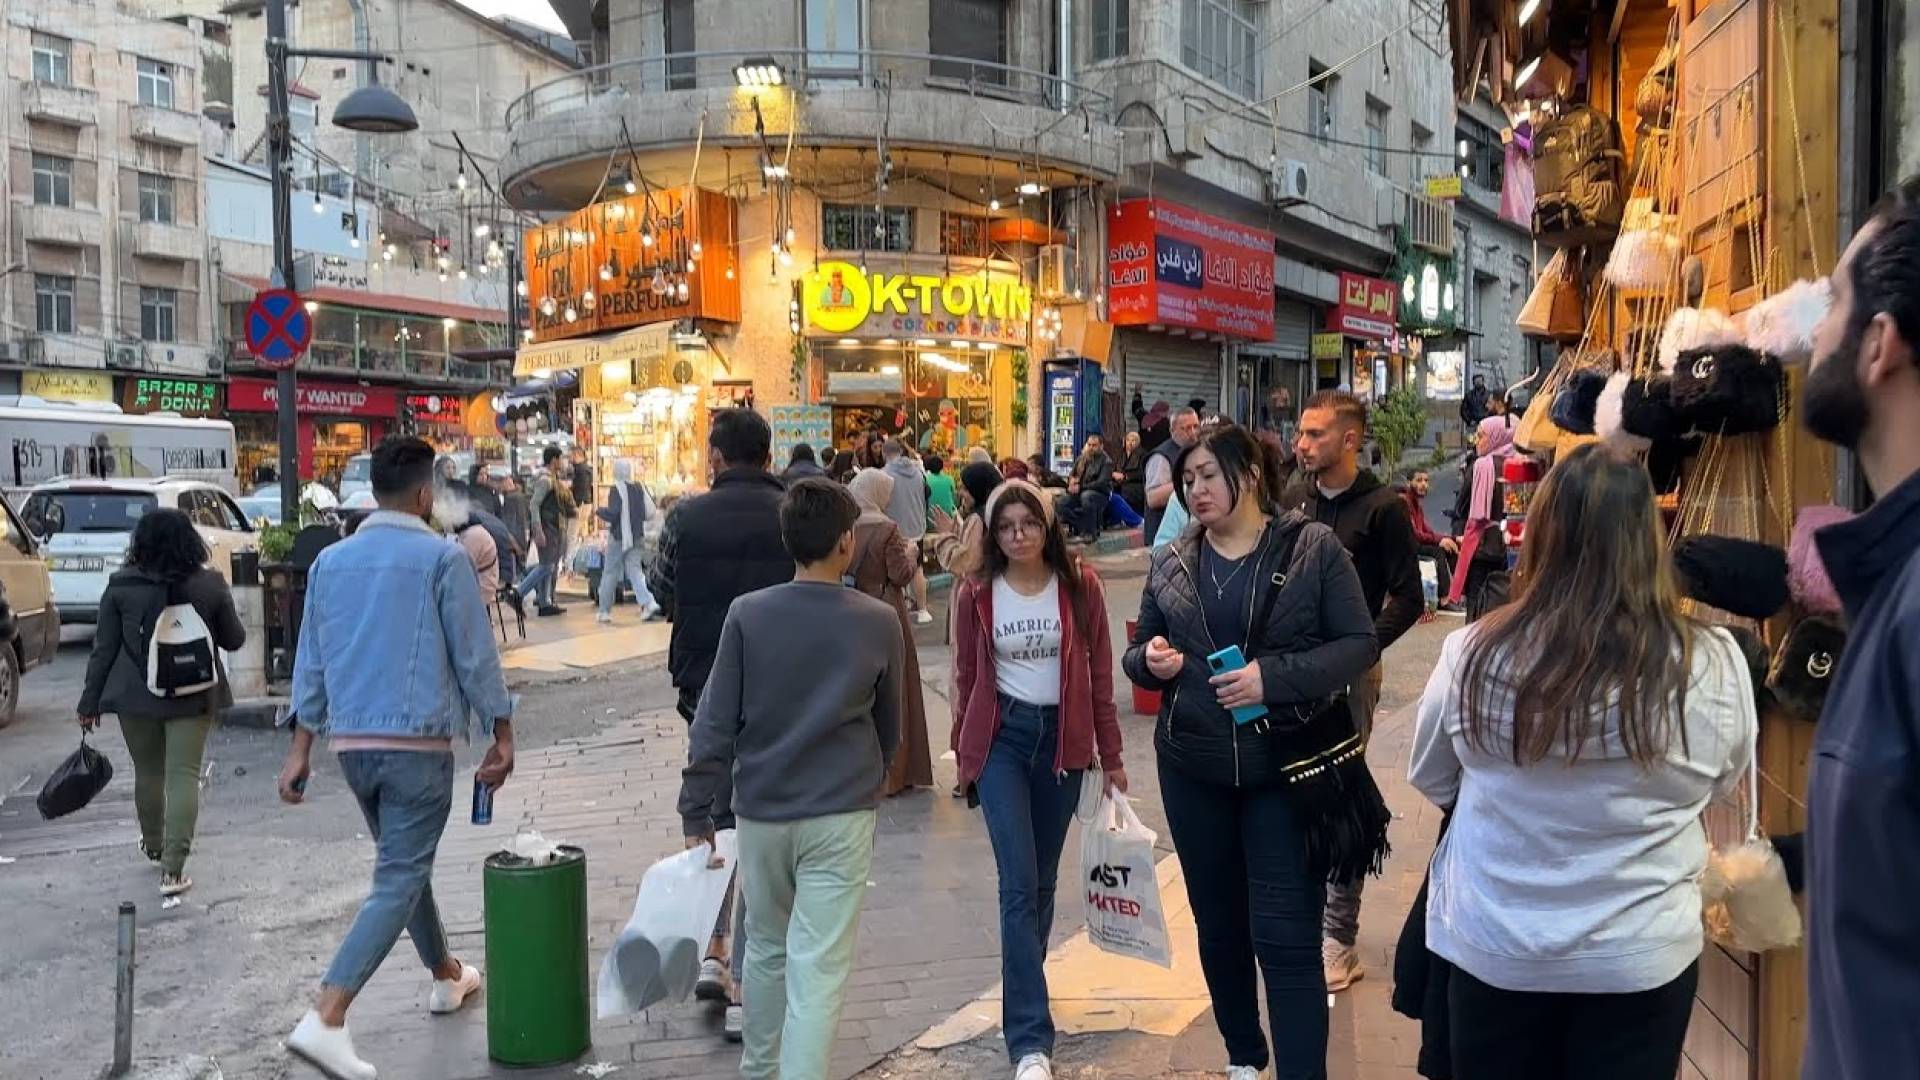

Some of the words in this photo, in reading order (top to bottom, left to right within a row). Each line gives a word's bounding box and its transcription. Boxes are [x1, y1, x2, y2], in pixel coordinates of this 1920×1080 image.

[138, 379, 198, 396] BAZAR
[263, 386, 303, 401] MT
[306, 389, 367, 405] WANTED
[160, 396, 211, 411] DONIA
[1025, 633, 1043, 647] 77
